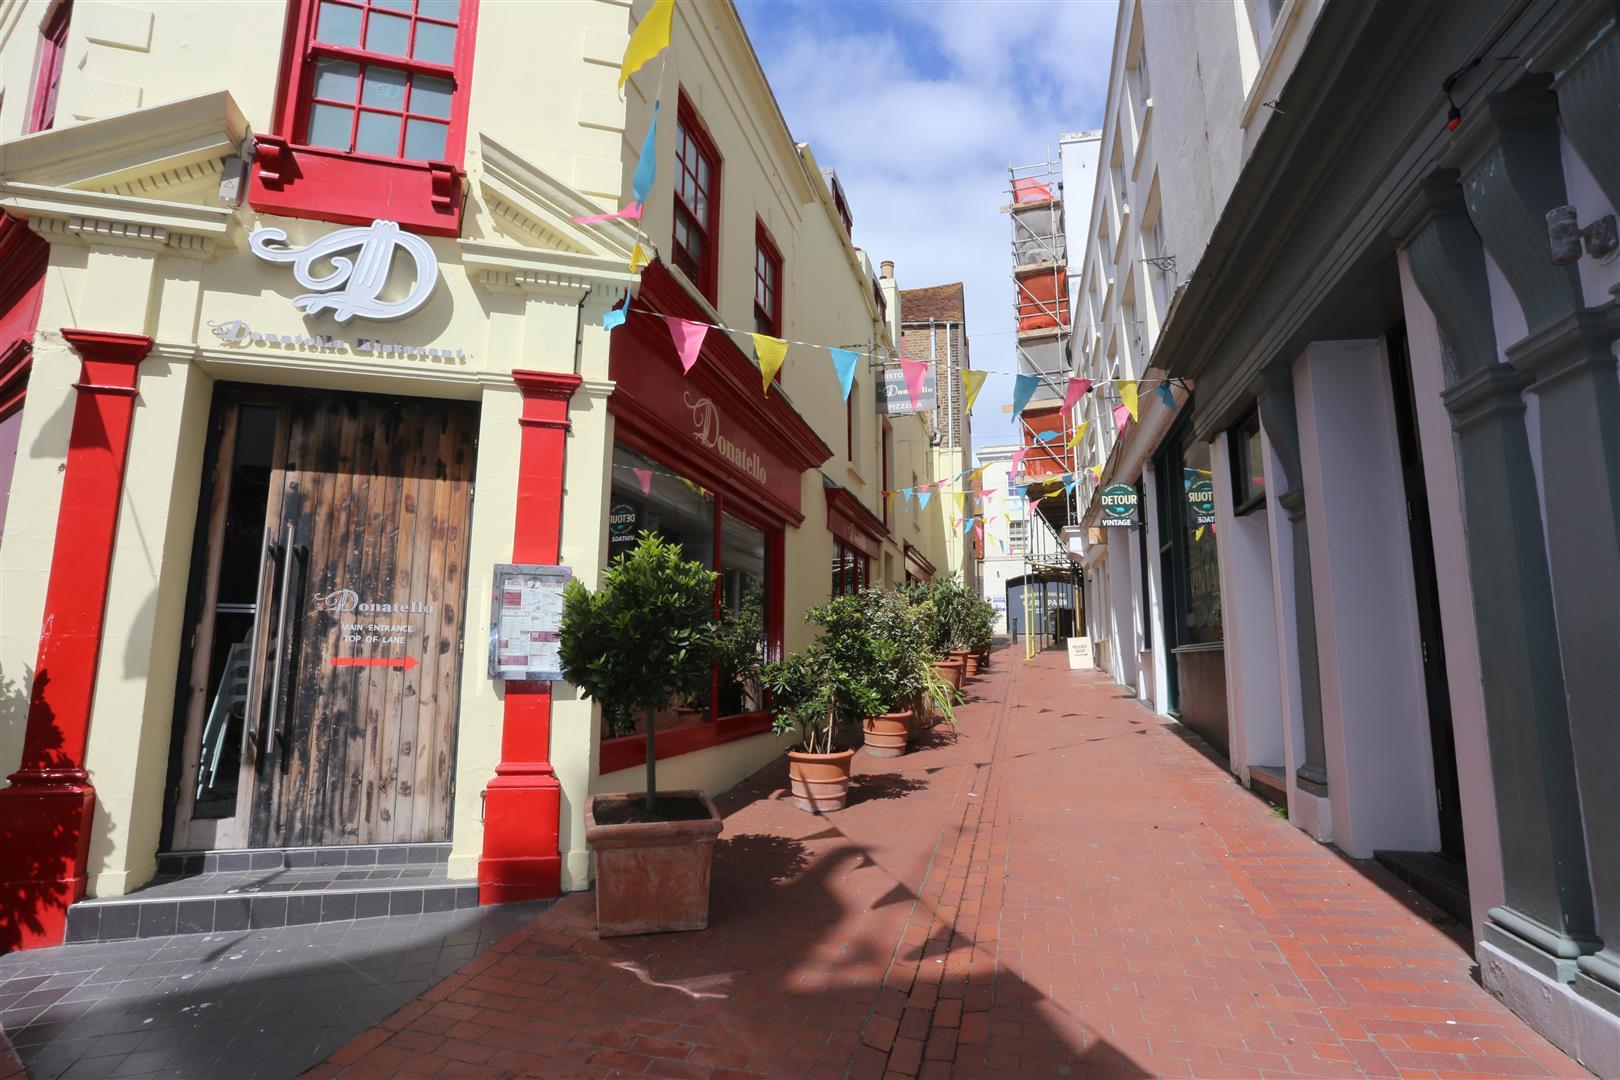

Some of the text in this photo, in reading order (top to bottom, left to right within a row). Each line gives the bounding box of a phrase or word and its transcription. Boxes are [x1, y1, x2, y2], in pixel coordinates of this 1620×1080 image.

[880, 384, 933, 398] Donllo
[684, 391, 767, 485] Donatello
[1101, 494, 1138, 506] DETOUR
[1101, 518, 1132, 527] VINTAGE
[314, 588, 434, 614] Donatello
[1047, 599, 1069, 607] PARK
[341, 623, 414, 634] MAIN ENTRANCE
[344, 635, 406, 645] TOP OF LANE
